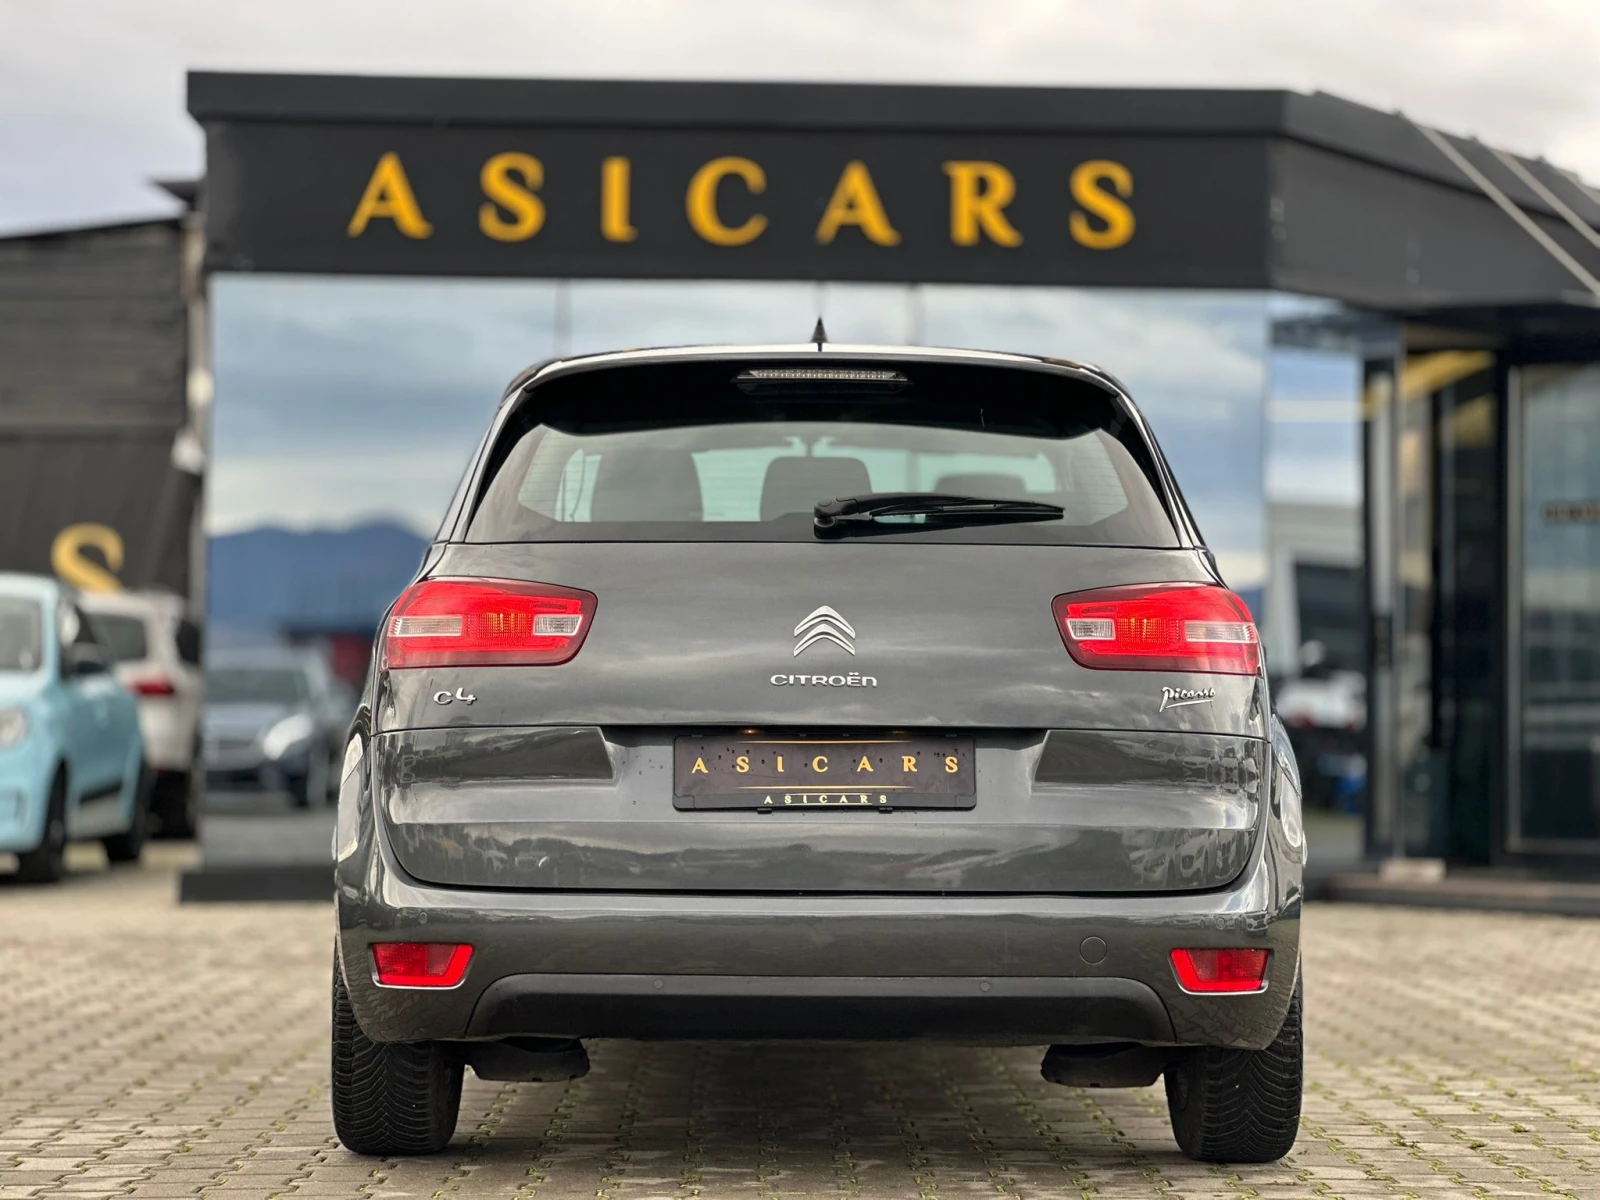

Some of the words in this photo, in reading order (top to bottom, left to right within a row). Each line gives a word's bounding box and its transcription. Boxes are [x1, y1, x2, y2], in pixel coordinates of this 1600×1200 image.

[347, 151, 1137, 249] ASICARS
[433, 687, 477, 705] C4
[691, 755, 959, 774] ASICARS
[764, 794, 887, 804] ASICARS
